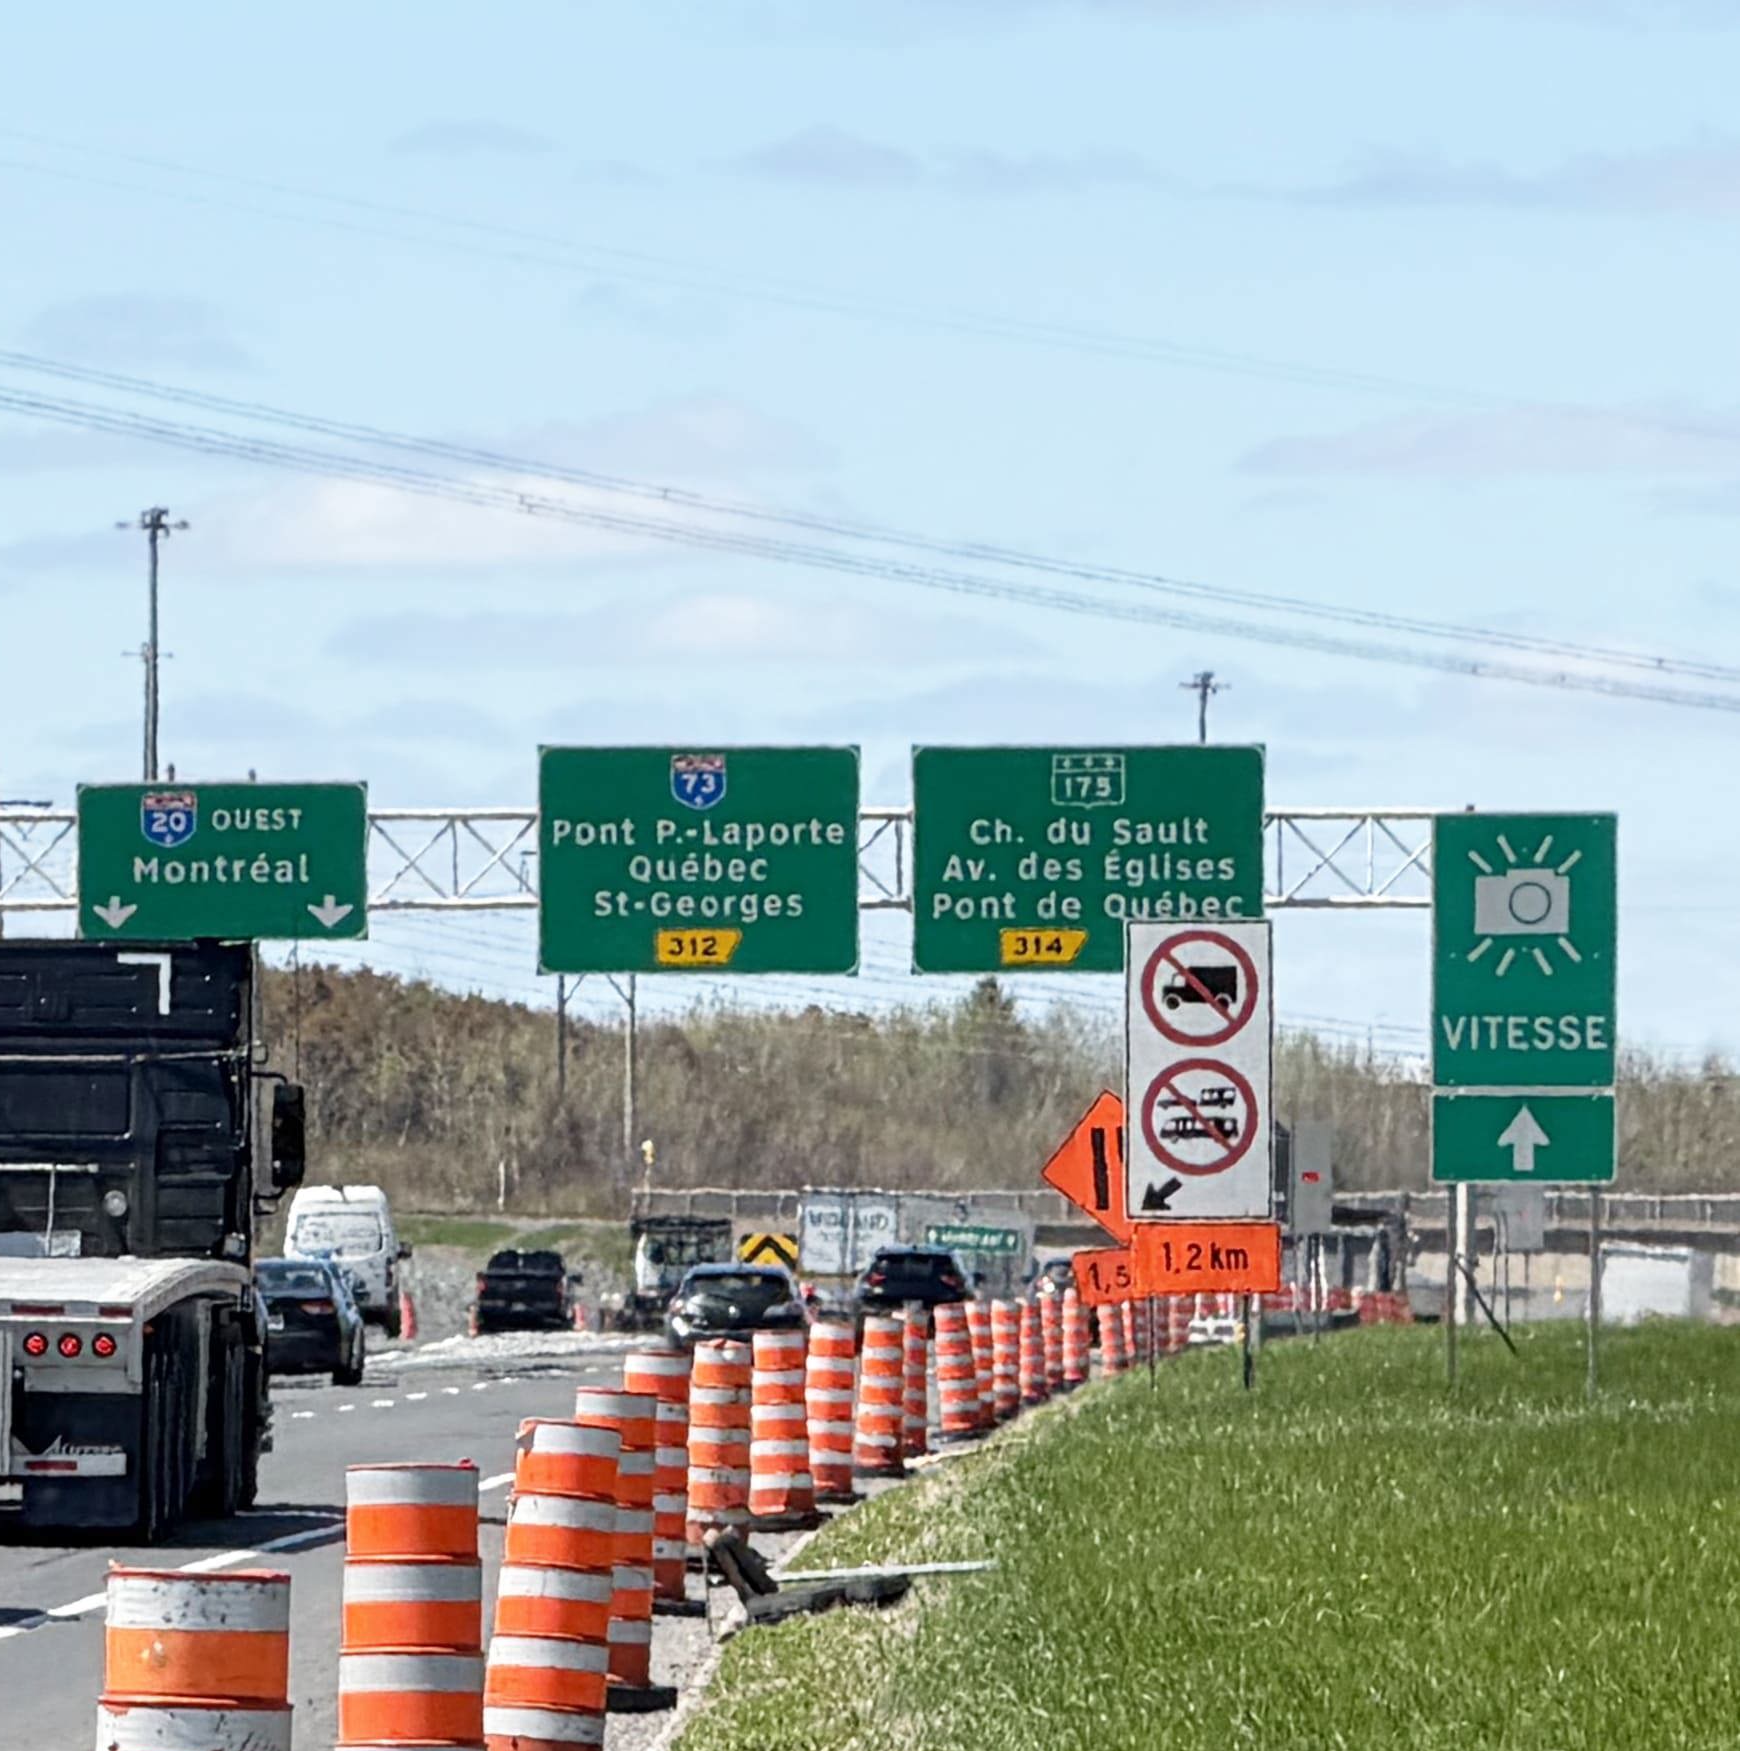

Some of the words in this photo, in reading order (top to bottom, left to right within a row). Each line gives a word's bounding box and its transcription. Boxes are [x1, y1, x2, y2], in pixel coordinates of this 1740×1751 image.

[681, 773, 716, 794] 73
[1065, 776, 1112, 798] 175
[150, 811, 188, 833] 20
[211, 808, 303, 831] OUEST
[552, 817, 635, 847] Pont
[656, 817, 846, 851] P.-Laporte
[969, 818, 1025, 845] Ch.
[1046, 817, 1091, 846] du
[1112, 816, 1209, 846] Sault
[132, 852, 310, 883] Montréal
[628, 852, 769, 883] Québec
[942, 854, 997, 882] Av.
[1017, 851, 1083, 882] des
[1103, 849, 1236, 887] Églises
[593, 890, 804, 923] St-Georges
[932, 891, 1017, 920] Pont
[1036, 890, 1083, 920] de
[1103, 890, 1244, 919] Québec
[666, 936, 719, 957] 312
[1013, 937, 1064, 956] 314
[1441, 1014, 1608, 1051] VITESSE
[1210, 1241, 1249, 1271] km
[1088, 1262, 1132, 1294] 1,5
